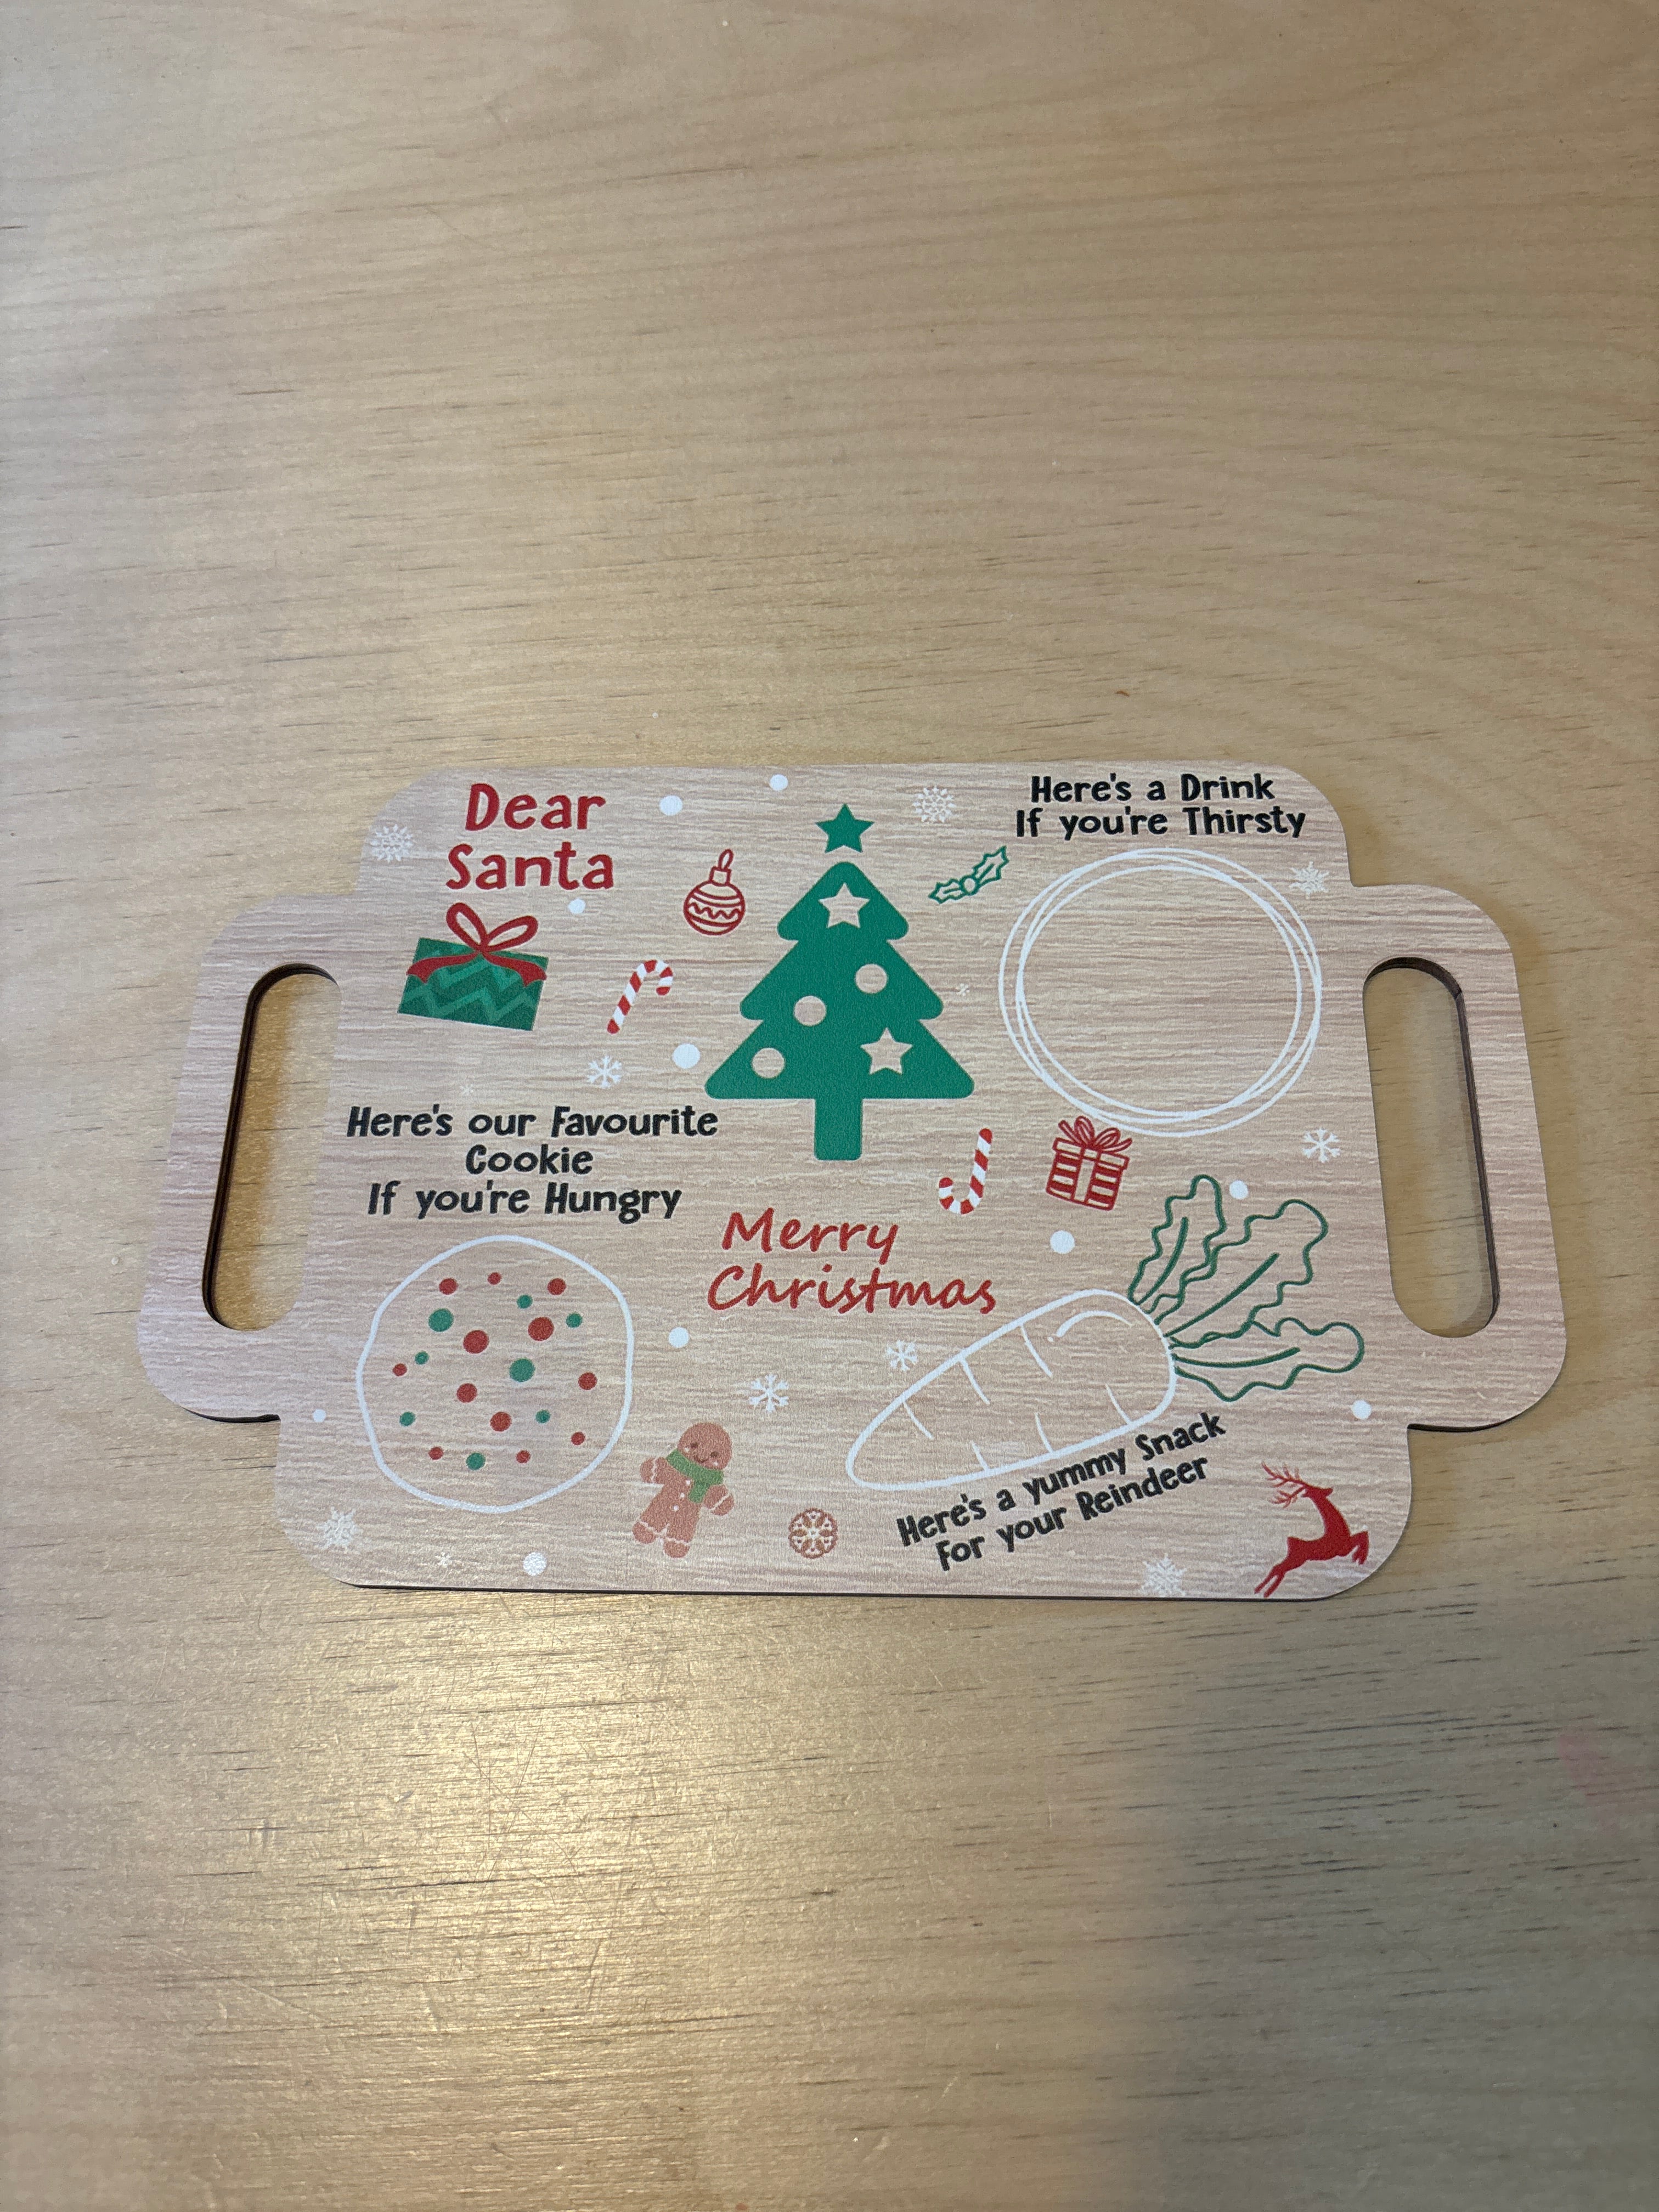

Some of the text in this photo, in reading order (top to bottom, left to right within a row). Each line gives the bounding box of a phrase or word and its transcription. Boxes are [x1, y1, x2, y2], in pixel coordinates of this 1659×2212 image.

[466, 783, 606, 831] Dear
[1030, 772, 1276, 803] Here's a Drink
[1016, 805, 1306, 841] If you're Thirsty
[445, 841, 613, 890] Santa
[346, 1103, 718, 1138] Here's our Favourite
[465, 1143, 594, 1175] Cookie
[368, 1180, 682, 1225] If you're Hungry
[721, 1207, 898, 1265] Merry
[707, 1262, 996, 1314] Christmas
[896, 1412, 1227, 1547] Here's a yummy Snack
[935, 1457, 1208, 1572] For your Reindeer
